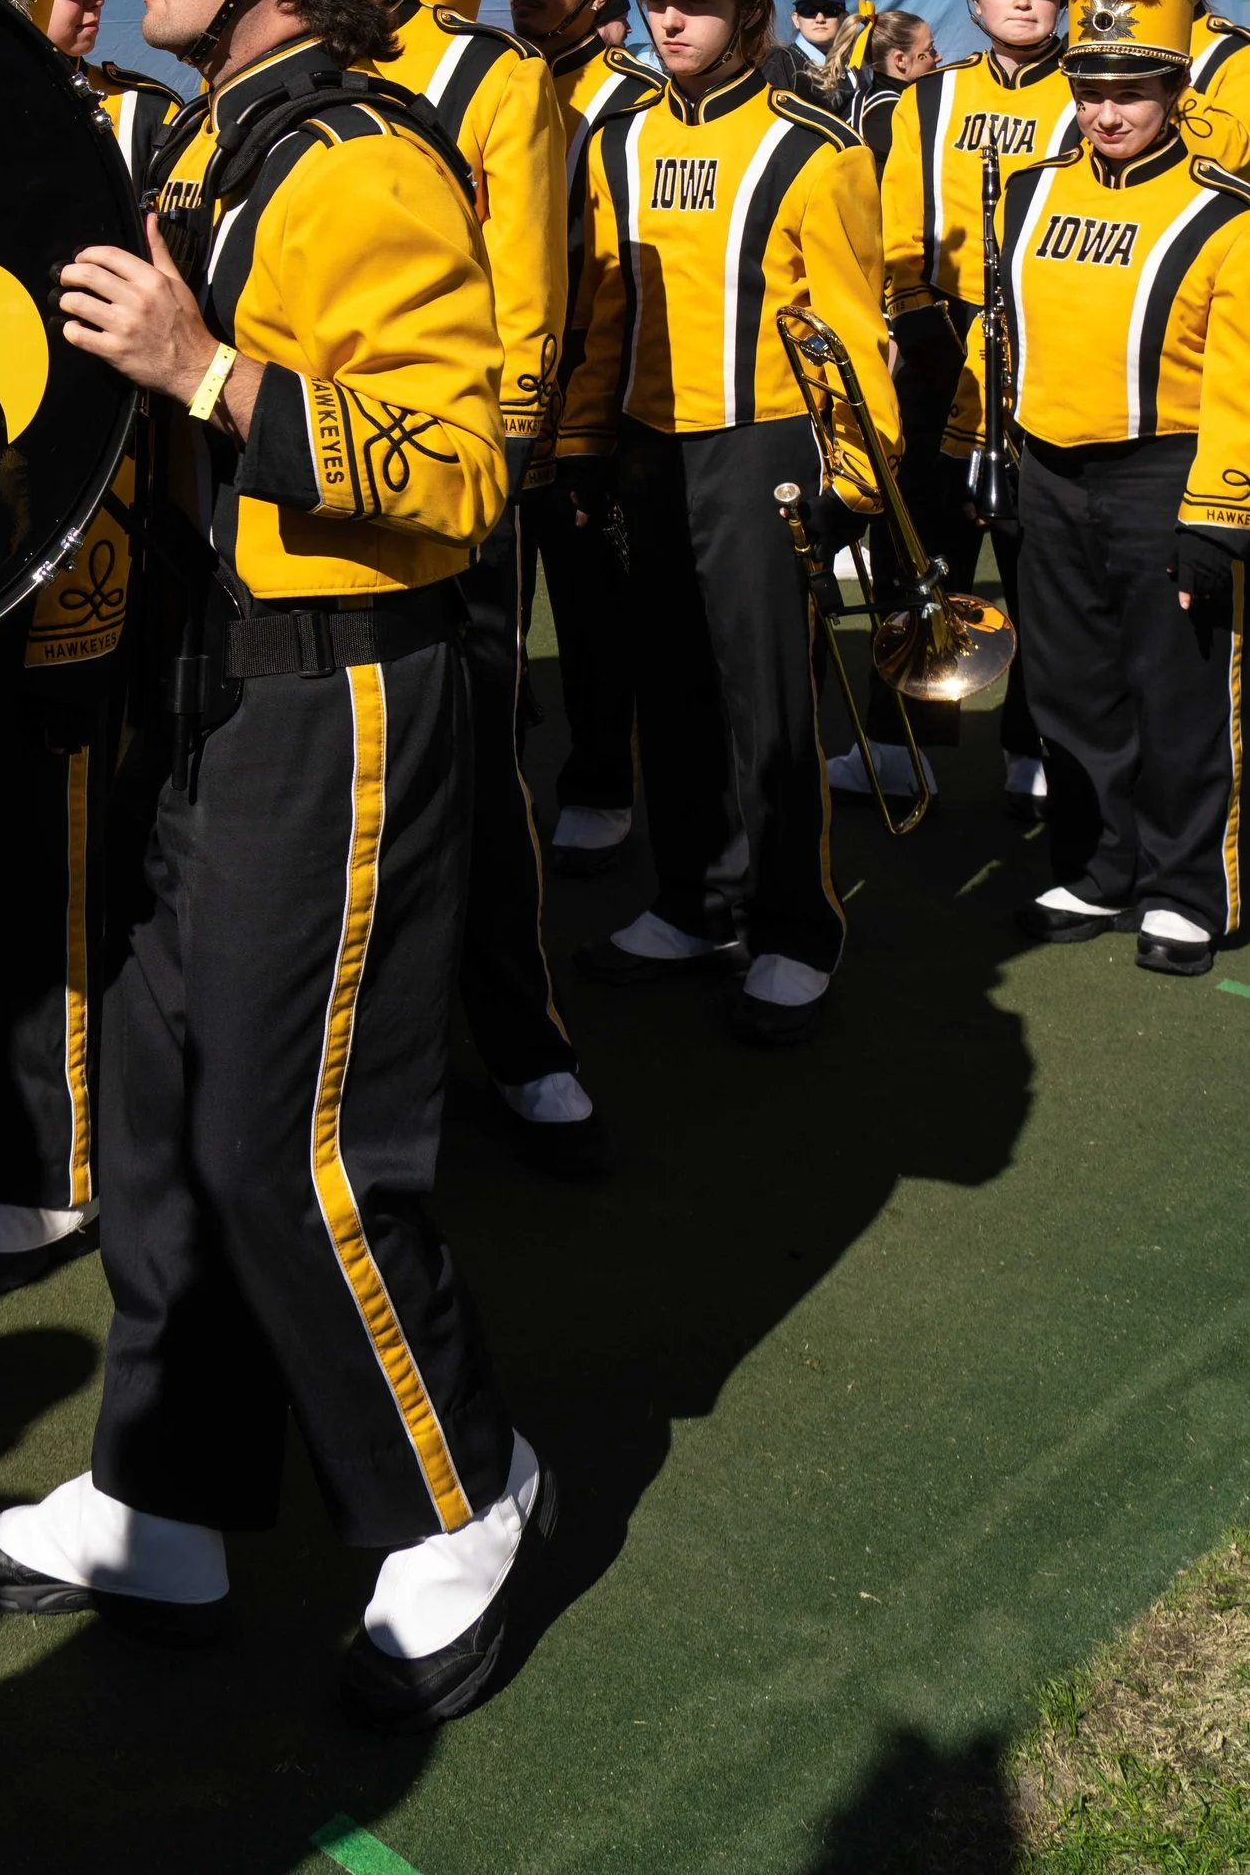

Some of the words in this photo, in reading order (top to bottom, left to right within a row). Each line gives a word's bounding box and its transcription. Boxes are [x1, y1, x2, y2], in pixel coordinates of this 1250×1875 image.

[953, 112, 1038, 154] IOWA
[650, 157, 719, 211] IOWA
[1034, 215, 1141, 268] IOWA
[44, 632, 117, 659] HAWKEYES
